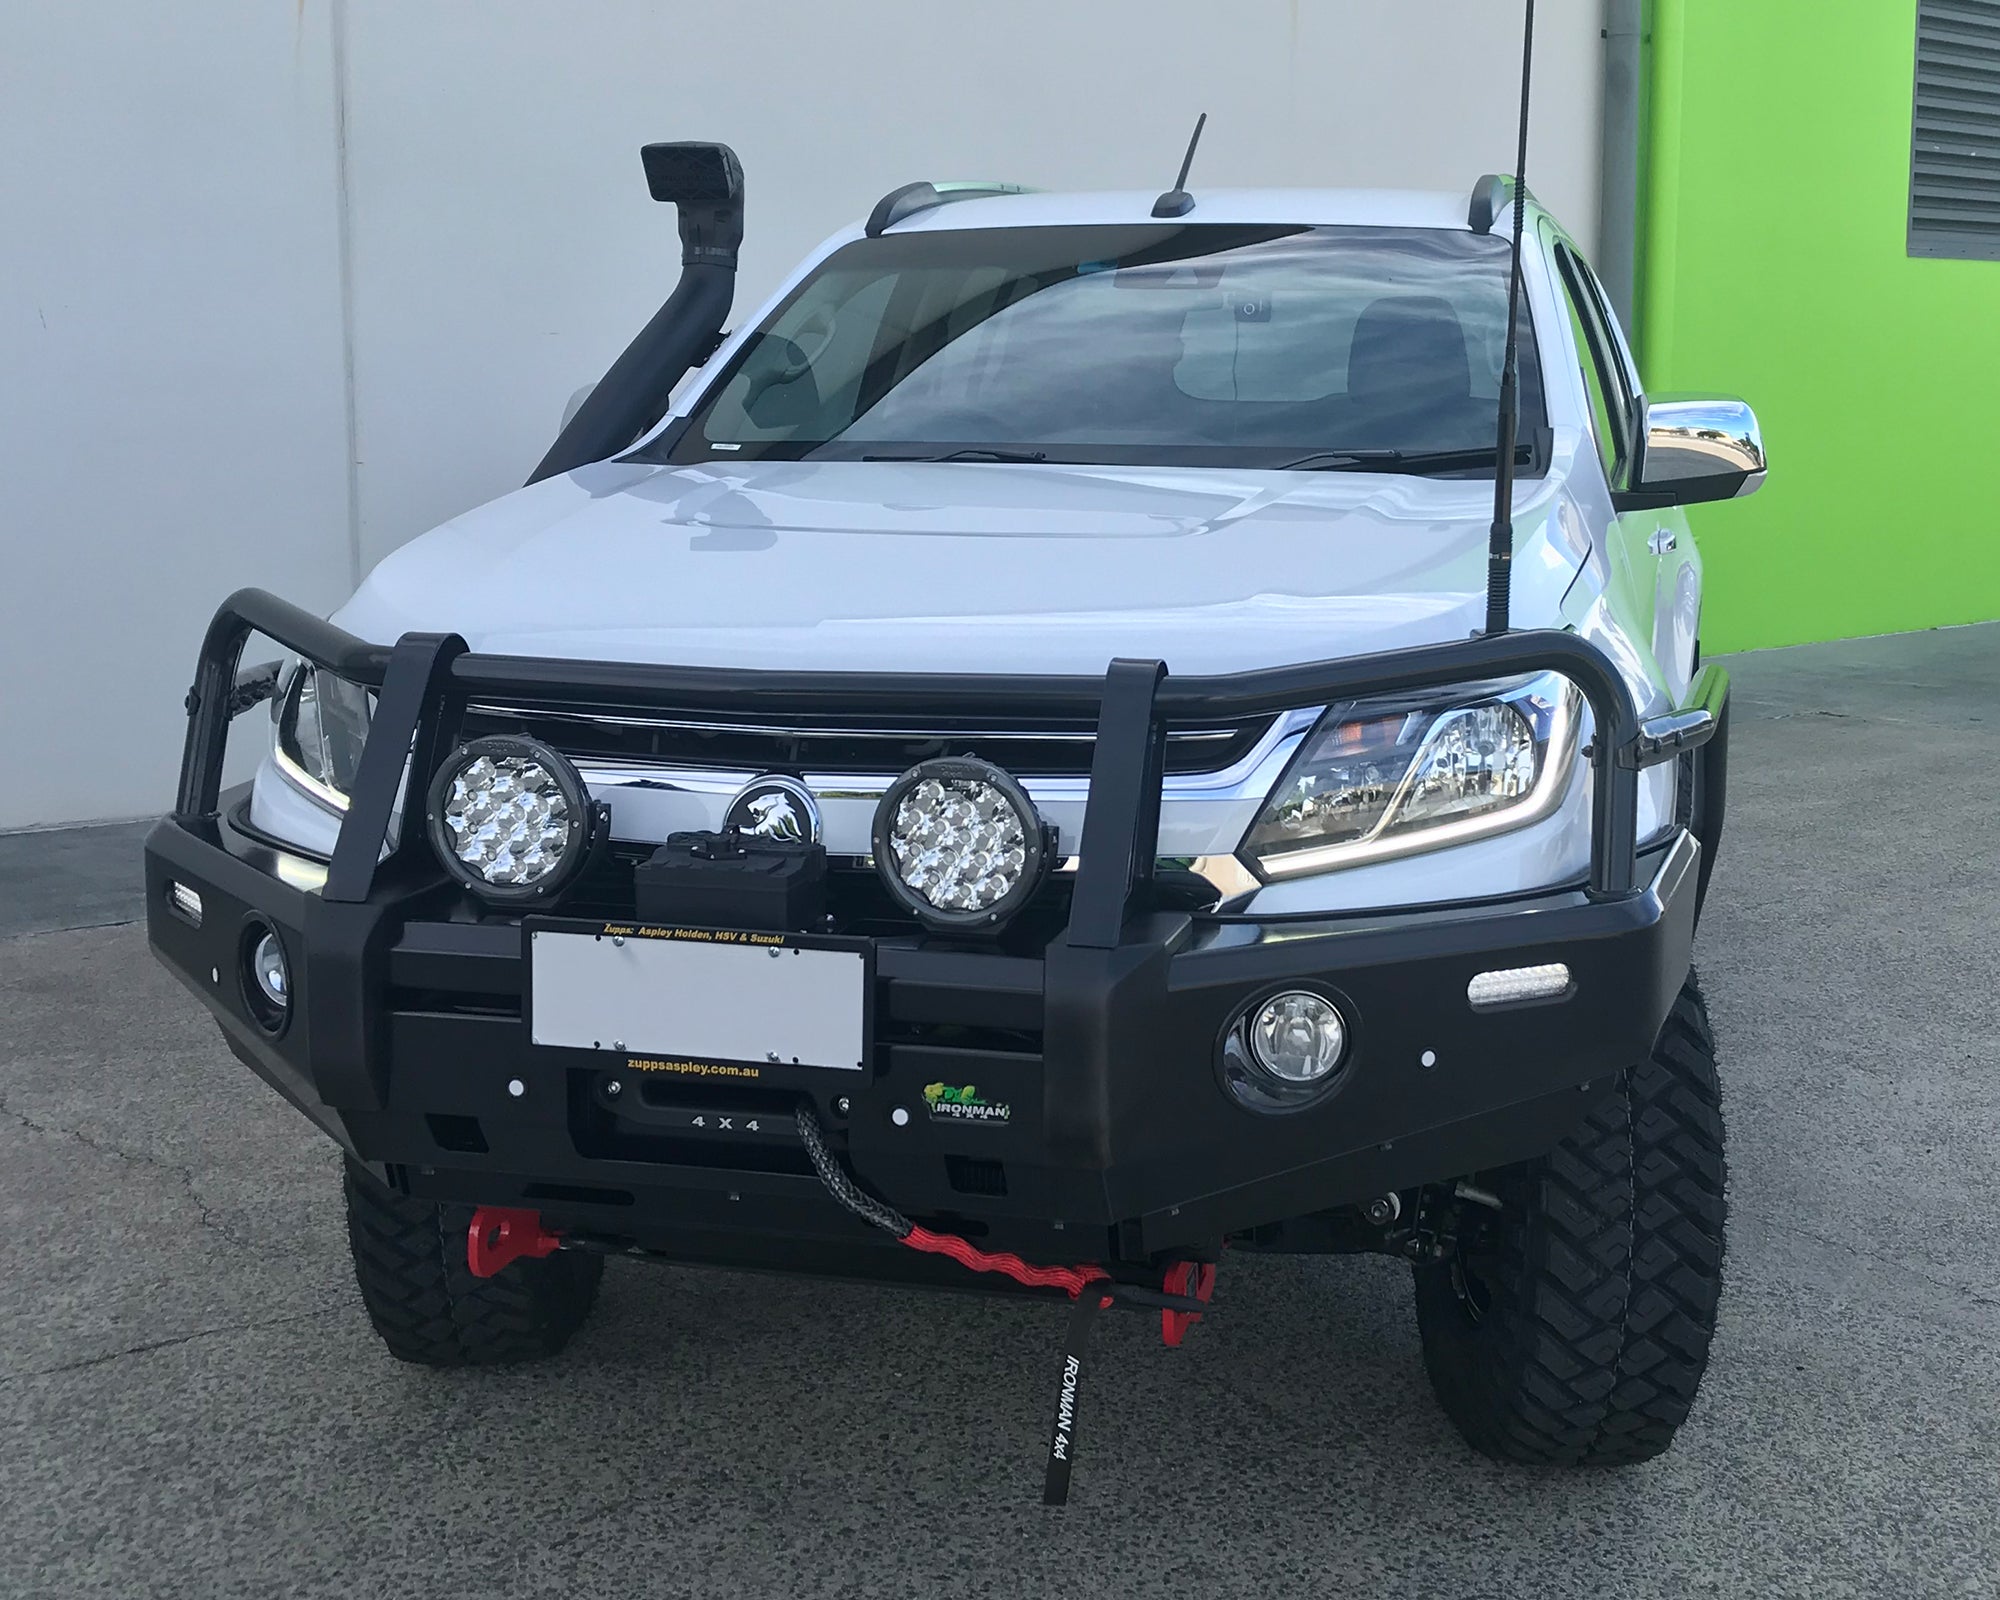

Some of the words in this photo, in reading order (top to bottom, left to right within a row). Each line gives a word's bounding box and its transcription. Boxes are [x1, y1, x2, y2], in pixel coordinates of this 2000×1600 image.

[638, 926, 672, 939] Aspley
[715, 931, 737, 941] HSV
[739, 933, 748, 942] &
[750, 933, 785, 944] Suzuki
[627, 1059, 760, 1078] zuppsaspley.com.au
[936, 1102, 1006, 1117] IRONMAN
[1057, 1354, 1080, 1432] IRONMAN
